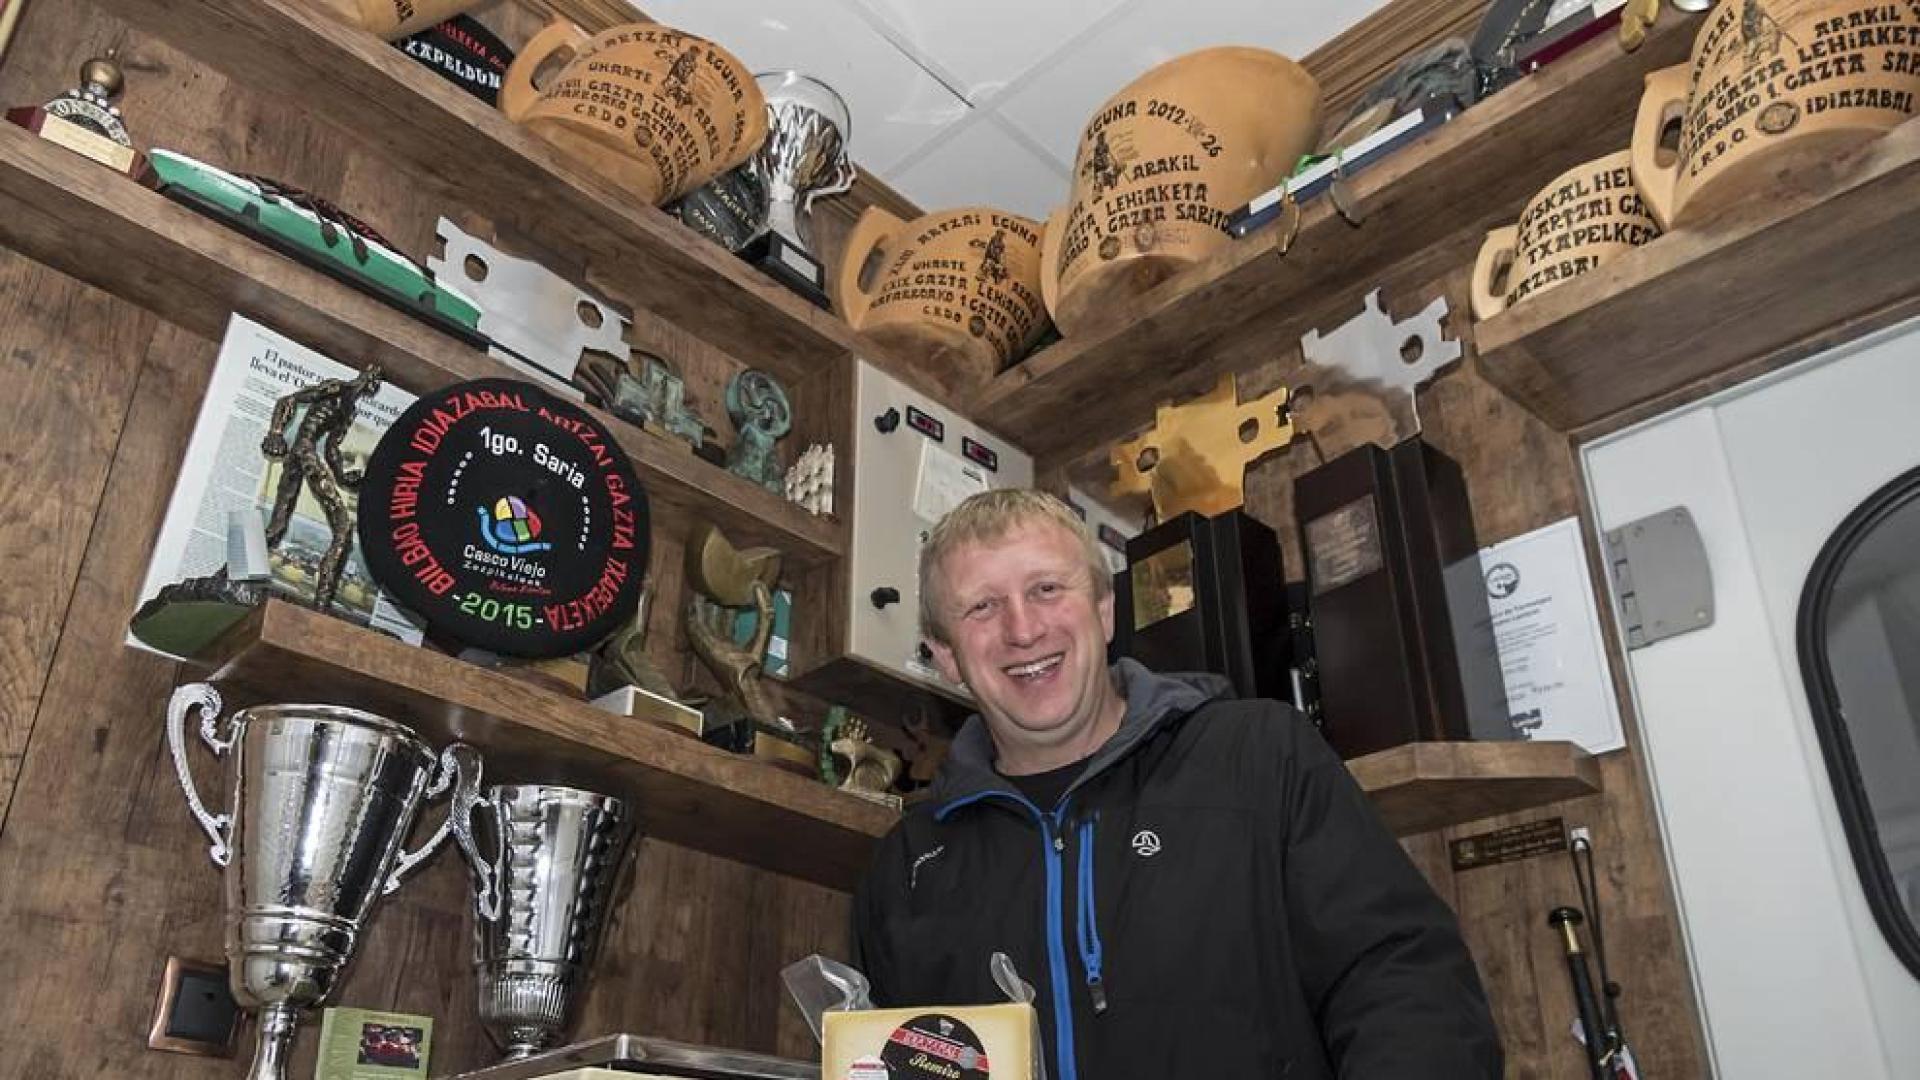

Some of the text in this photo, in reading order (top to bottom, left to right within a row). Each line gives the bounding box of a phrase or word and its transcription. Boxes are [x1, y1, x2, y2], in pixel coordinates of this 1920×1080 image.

[411, 391, 530, 456] IDIAZABAL
[389, 460, 428, 519] HIRIA
[480, 426, 586, 490] 1go. Saria
[393, 522, 456, 596] BILBAO
[463, 544, 547, 579] Casco Viejo
